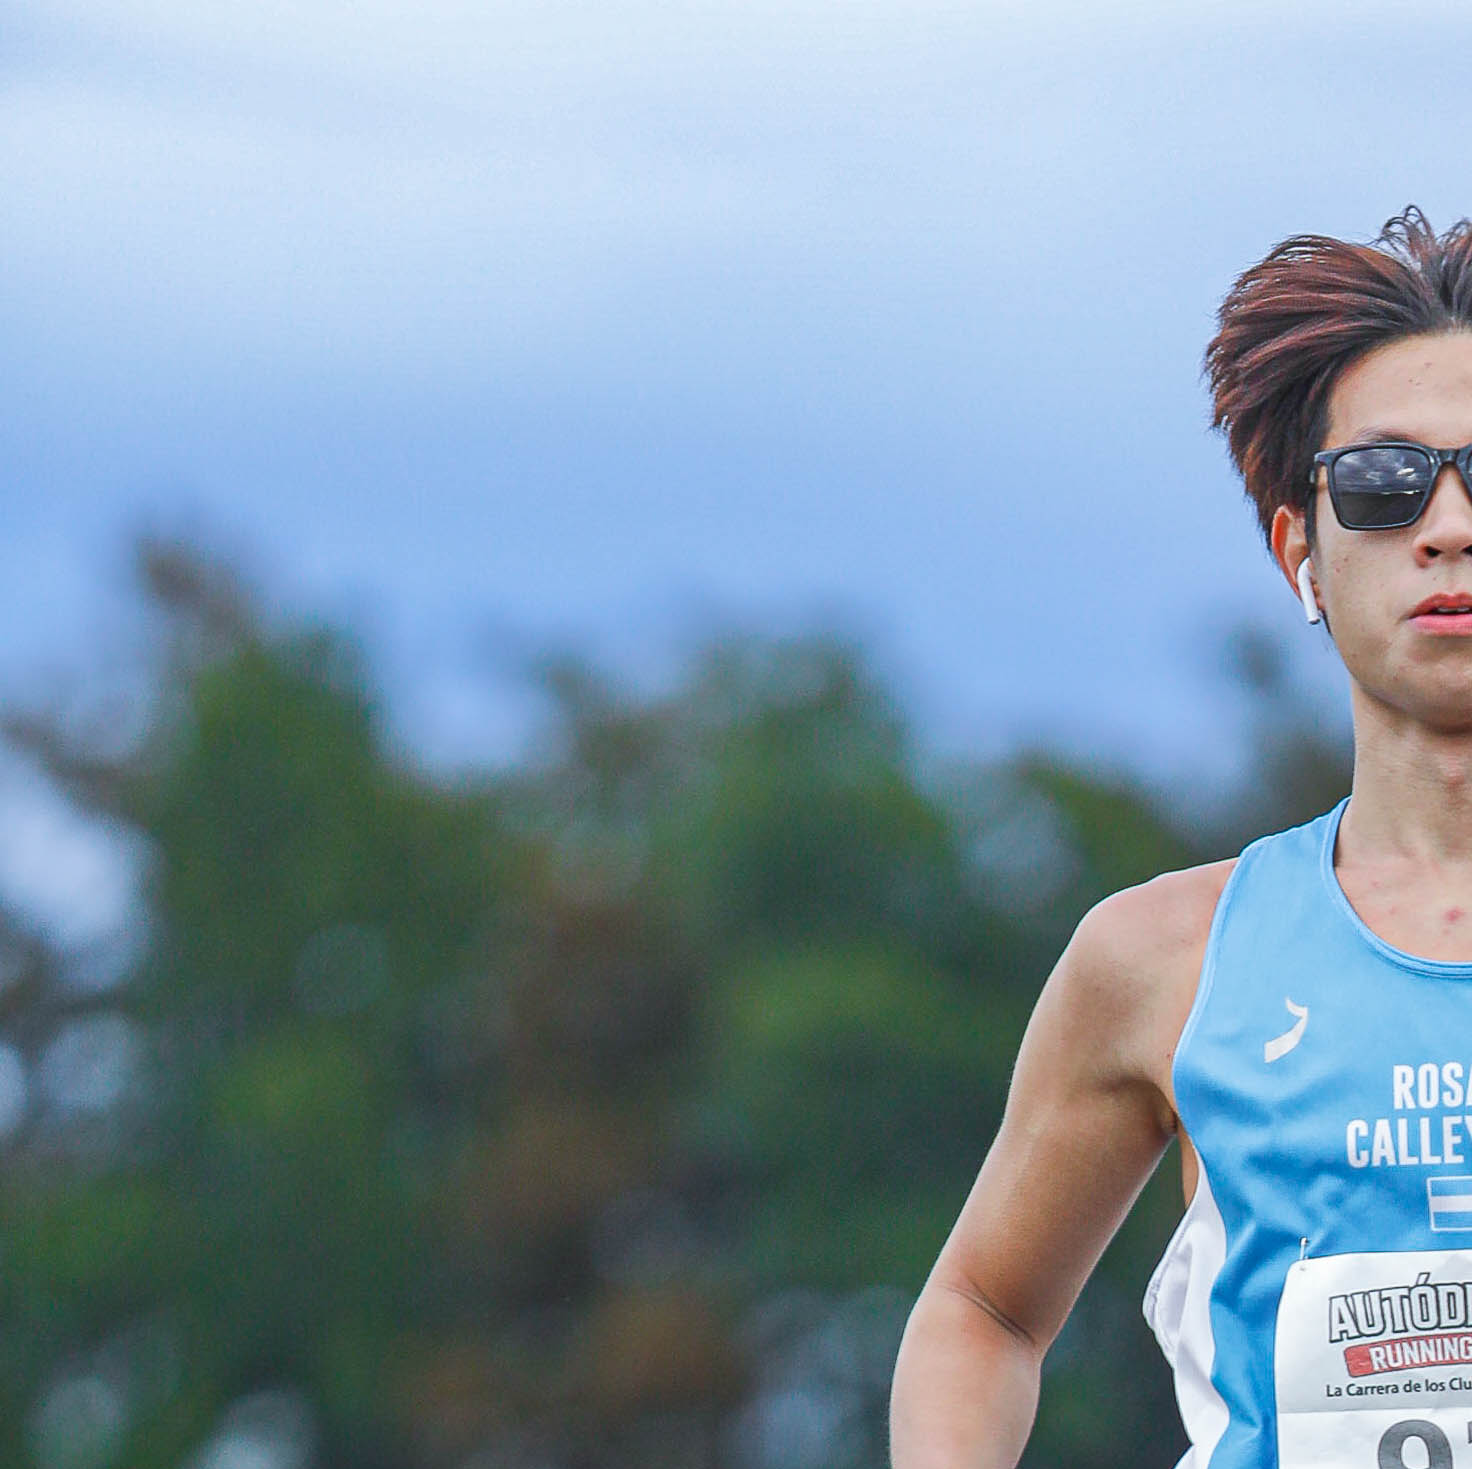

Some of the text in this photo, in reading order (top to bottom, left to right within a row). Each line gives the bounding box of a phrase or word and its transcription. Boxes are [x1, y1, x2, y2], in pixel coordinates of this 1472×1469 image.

[1326, 1384, 1343, 1398] La
[1346, 1383, 1399, 1397] Carrera
[1404, 1380, 1421, 1394] de
[1425, 1378, 1446, 1392] los
